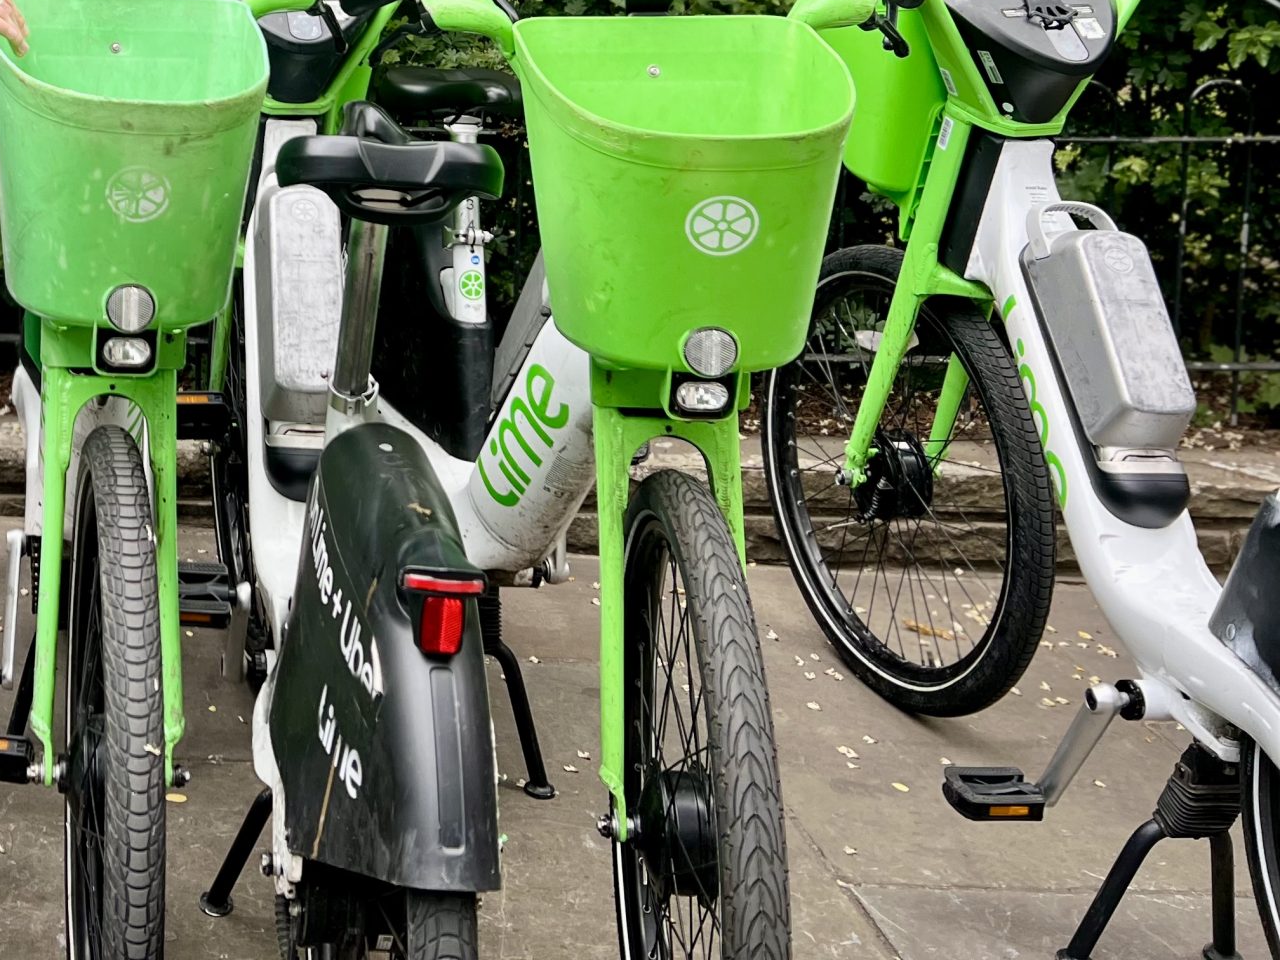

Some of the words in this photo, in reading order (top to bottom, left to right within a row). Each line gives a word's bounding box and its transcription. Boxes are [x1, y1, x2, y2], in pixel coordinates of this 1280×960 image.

[478, 363, 570, 507] Lime
[332, 588, 343, 619] +
[339, 600, 376, 700] Ube
